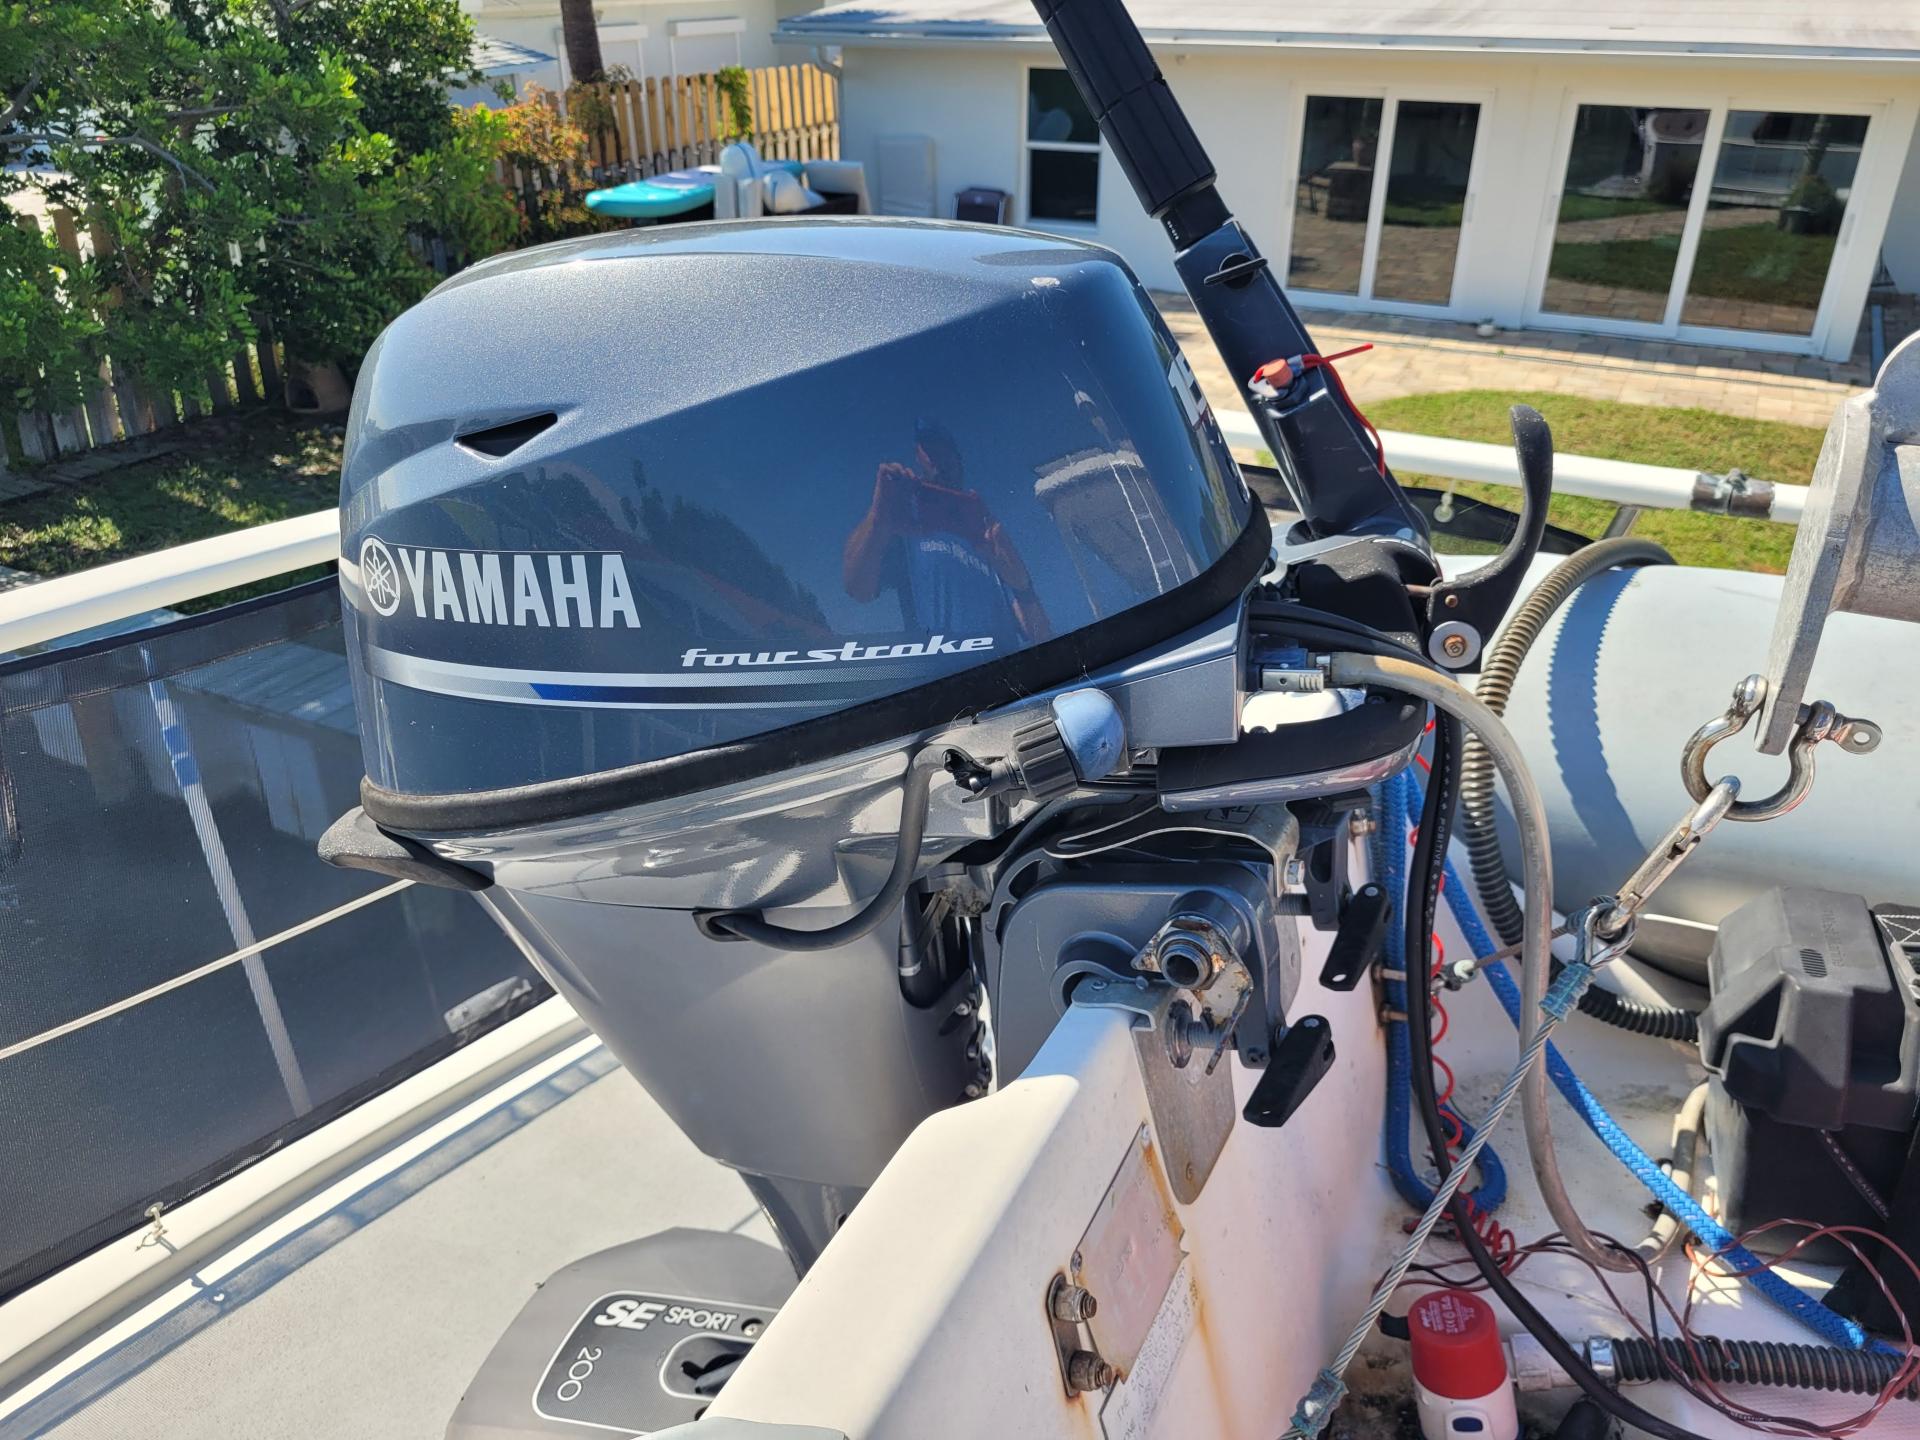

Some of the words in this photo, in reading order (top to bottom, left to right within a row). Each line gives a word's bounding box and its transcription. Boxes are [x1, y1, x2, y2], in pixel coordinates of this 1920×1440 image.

[398, 547, 641, 628] YAMAHA
[595, 1299, 665, 1330] SE
[664, 1306, 737, 1332] SPORT
[557, 1348, 602, 1401] 200
